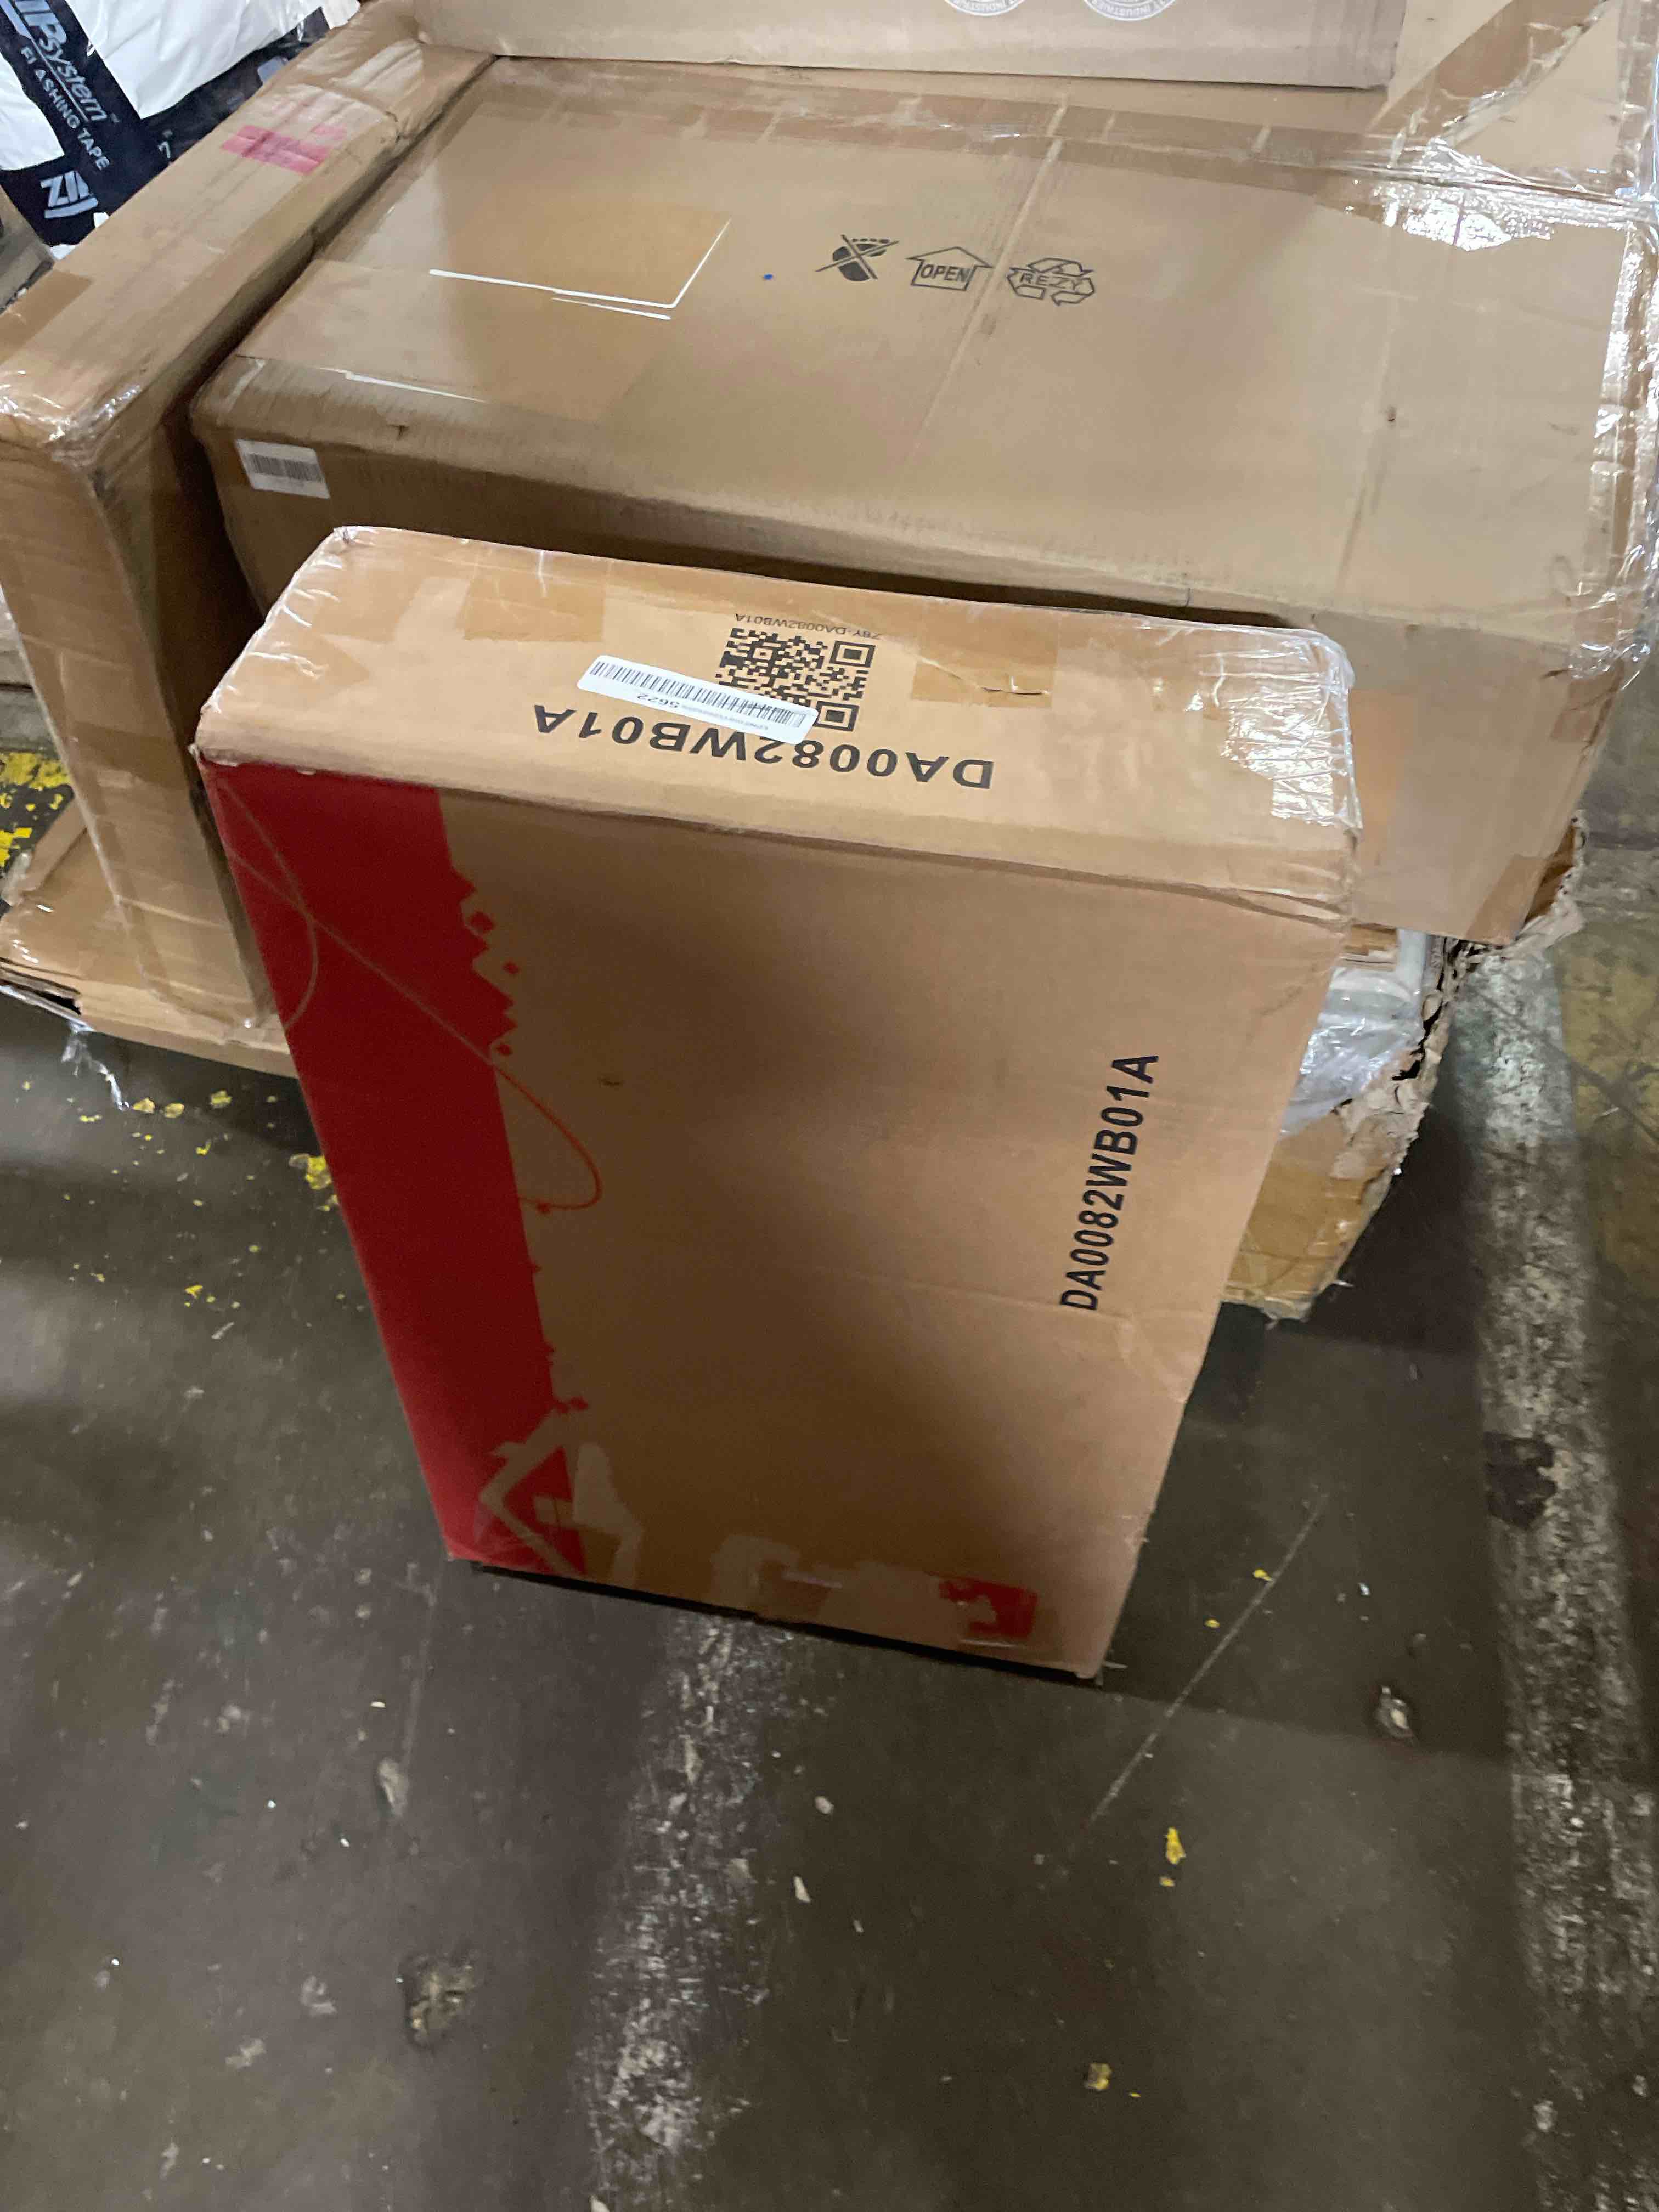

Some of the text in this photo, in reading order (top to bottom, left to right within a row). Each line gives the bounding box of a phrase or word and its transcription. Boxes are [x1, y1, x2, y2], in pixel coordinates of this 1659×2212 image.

[77, 127, 110, 171] TAPE
[921, 264, 972, 282] OPEN
[1020, 273, 1084, 290] REZY
[533, 705, 994, 789] DA0082WB01A
[1059, 1055, 1159, 1311] DA0082WB01A
